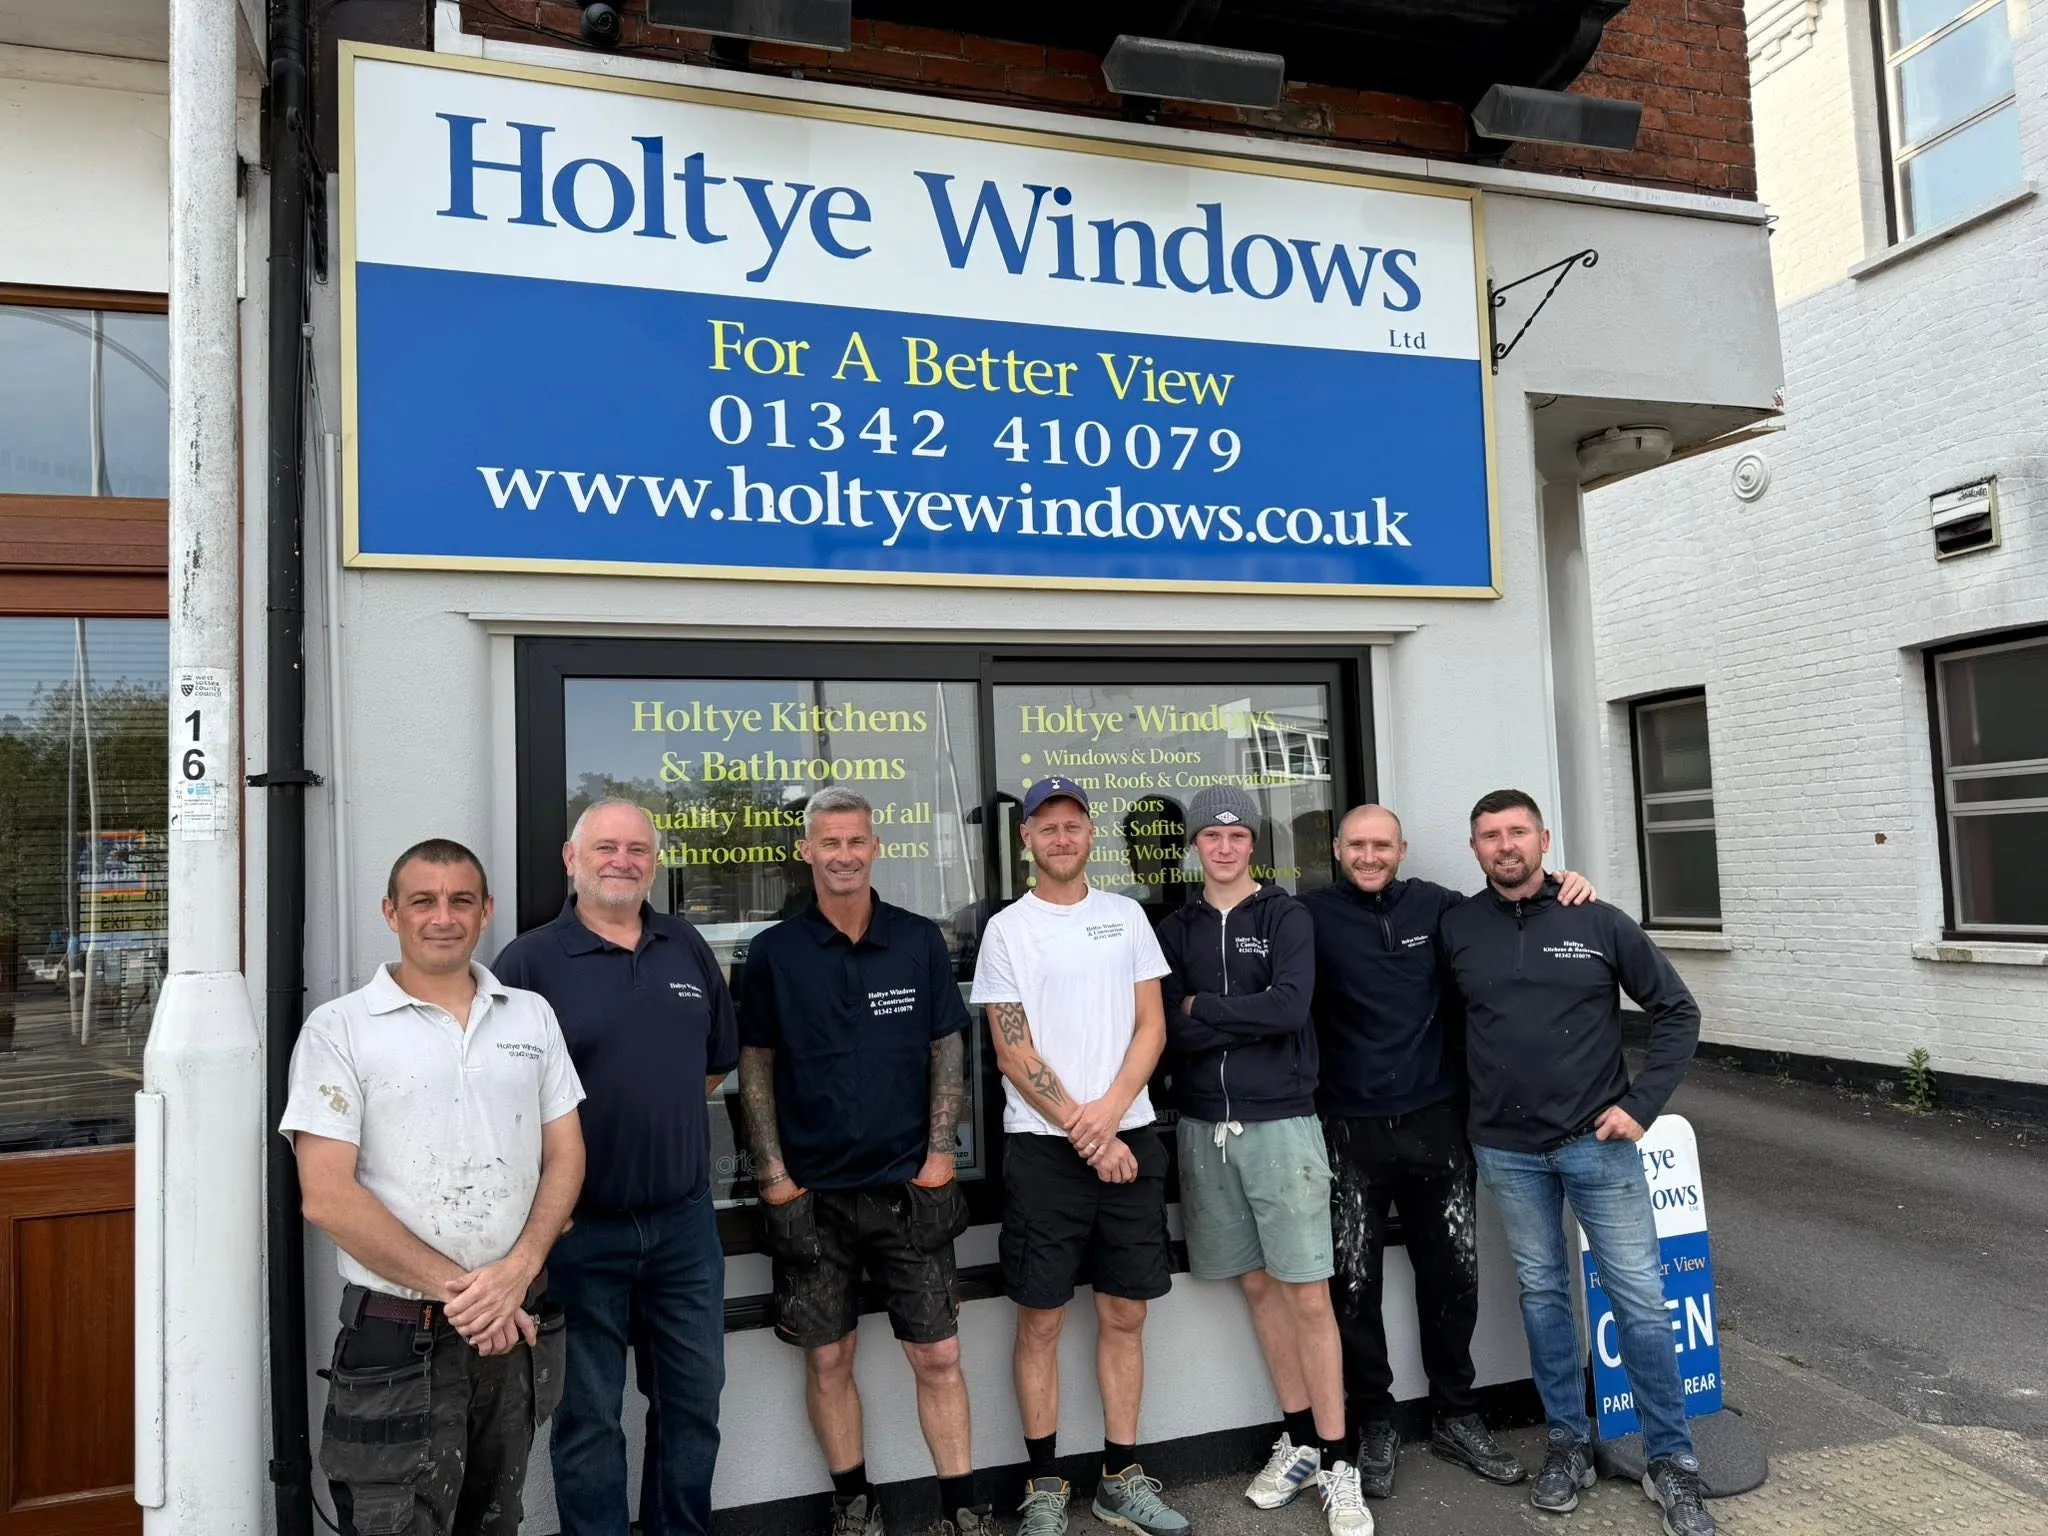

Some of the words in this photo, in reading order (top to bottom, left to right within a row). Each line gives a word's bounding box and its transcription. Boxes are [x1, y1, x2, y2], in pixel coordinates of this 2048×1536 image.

[436, 112, 872, 283] Holtye
[913, 171, 1422, 312] Windows
[1389, 329, 1427, 350] Ltd
[707, 319, 810, 376] For
[832, 332, 881, 383] A
[903, 336, 1078, 398] Better
[1097, 352, 1235, 406] View
[709, 394, 948, 459] 01342
[993, 415, 1242, 474] 410079
[477, 465, 1412, 547] www.holtyewindows.co.uk
[185, 710, 202, 742] 1
[631, 701, 762, 742] Holtye
[770, 702, 928, 733] Kitchens
[1019, 705, 1124, 742] Holtye
[1133, 704, 1276, 734] Windows
[182, 749, 206, 781] 6
[658, 751, 691, 783] &
[701, 750, 906, 782] Bathrooms
[1043, 749, 1128, 766] Windows
[1131, 749, 1146, 765] &
[1150, 748, 1201, 765] Doors
[1104, 771, 1154, 789] Roofs
[1157, 771, 1172, 788] &
[872, 802, 897, 825] of
[900, 802, 931, 824] all
[1112, 797, 1165, 813] Doors
[1112, 821, 1127, 838] &
[1130, 819, 1185, 837] Soffits
[658, 842, 787, 866] athrooms
[1134, 843, 1191, 860] Works
[1148, 867, 1167, 884] of
[1249, 863, 1302, 880] Works
[1673, 1256, 1706, 1273] View
[1597, 1293, 1714, 1368] OEN
[1684, 1373, 1717, 1396] REAR
